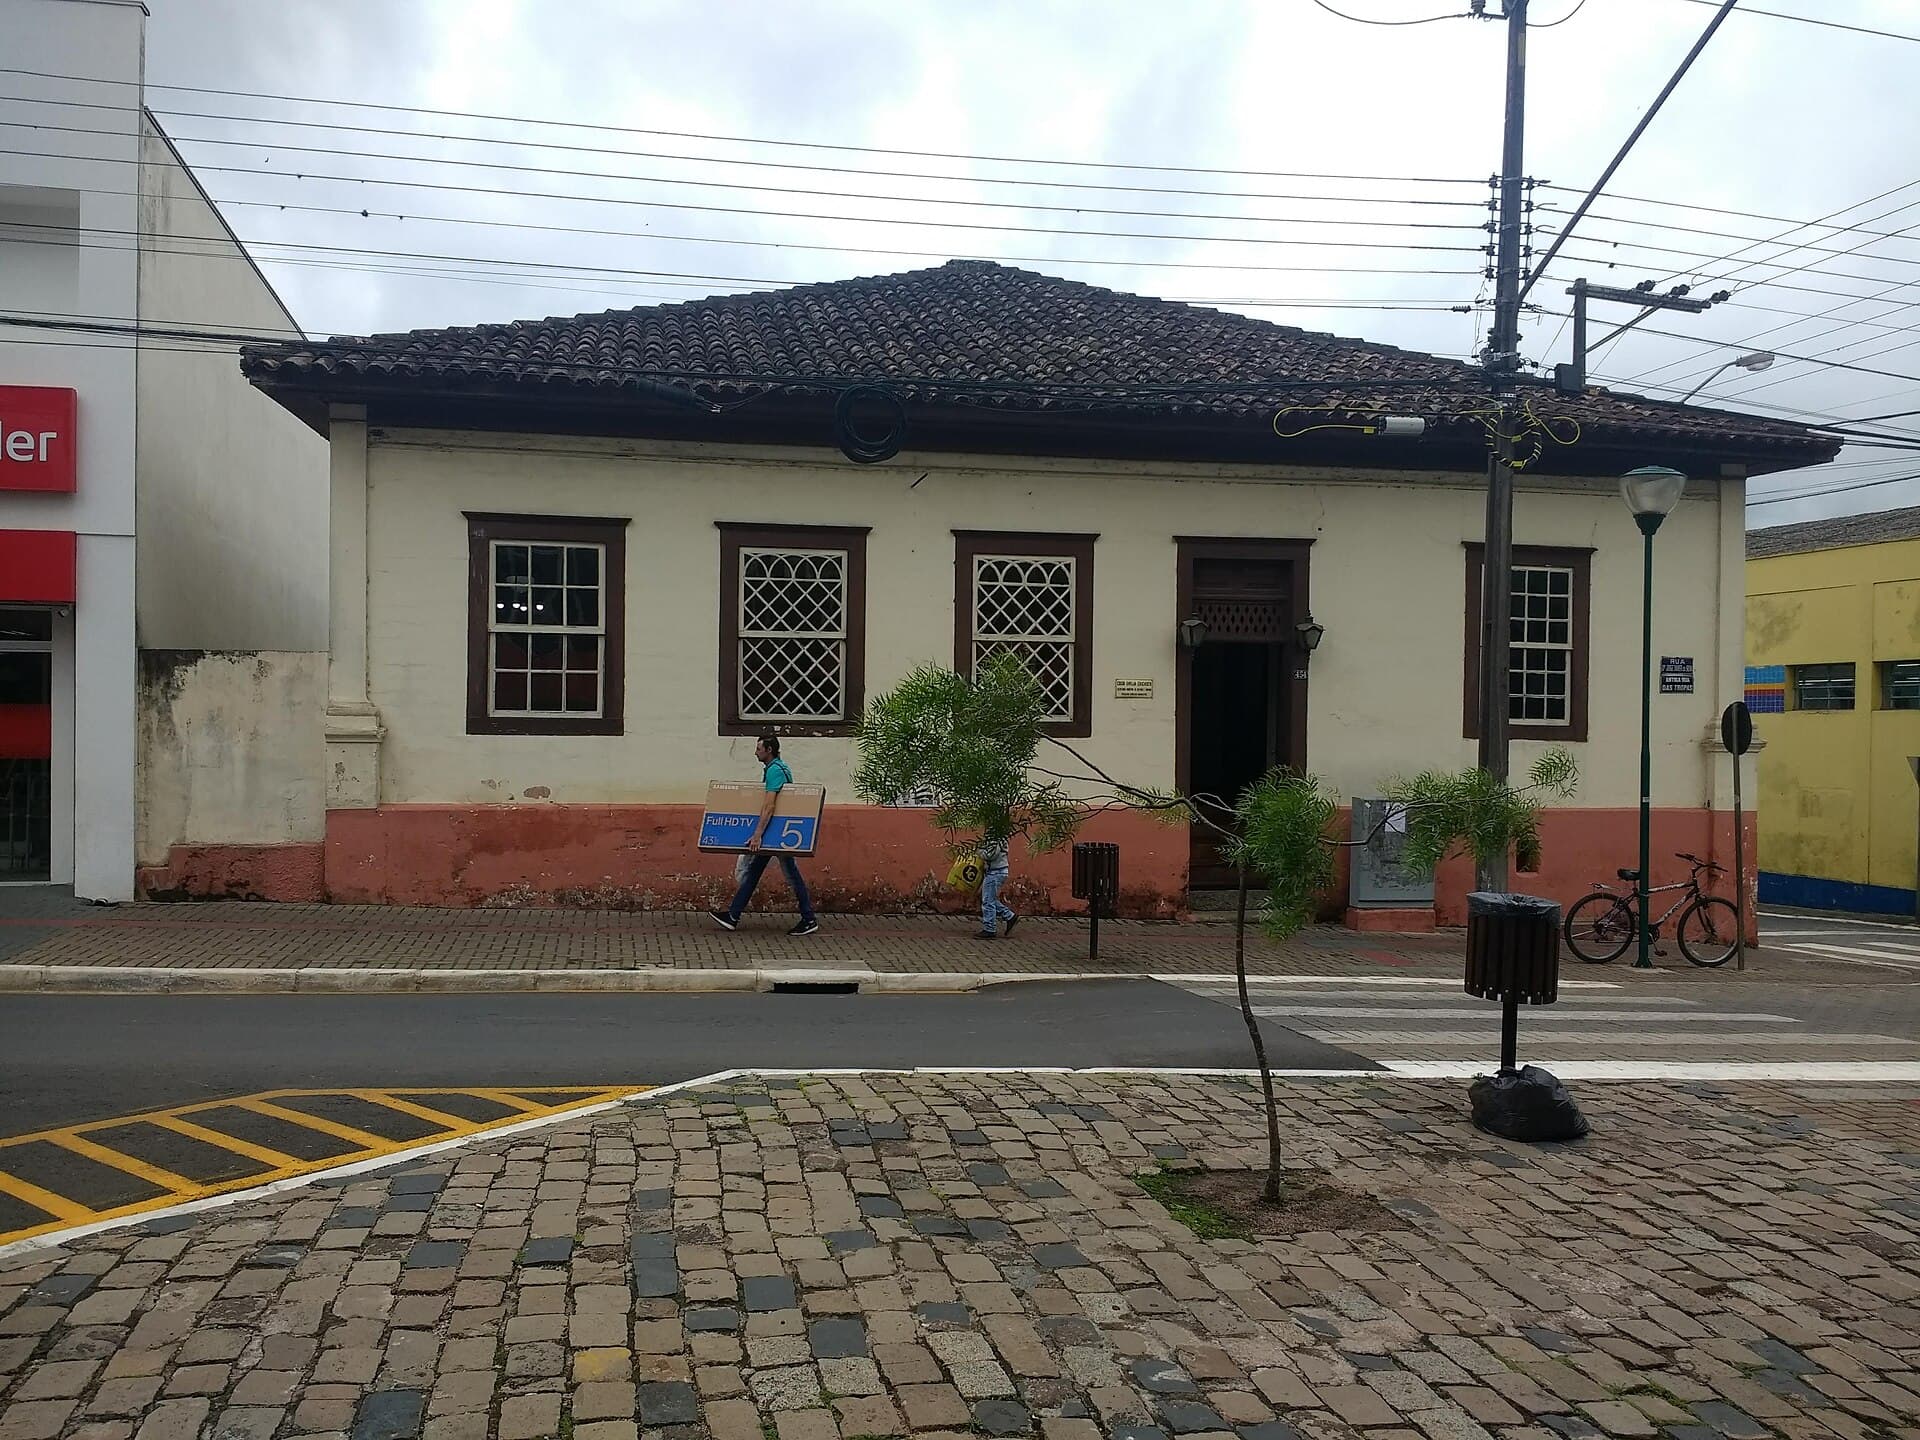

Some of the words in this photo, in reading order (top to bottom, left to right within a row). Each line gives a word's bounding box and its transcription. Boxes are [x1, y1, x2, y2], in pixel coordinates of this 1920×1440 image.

[706, 816, 723, 826] Full
[724, 816, 739, 827] HD
[740, 817, 754, 828] TV
[780, 819, 804, 850] 5
